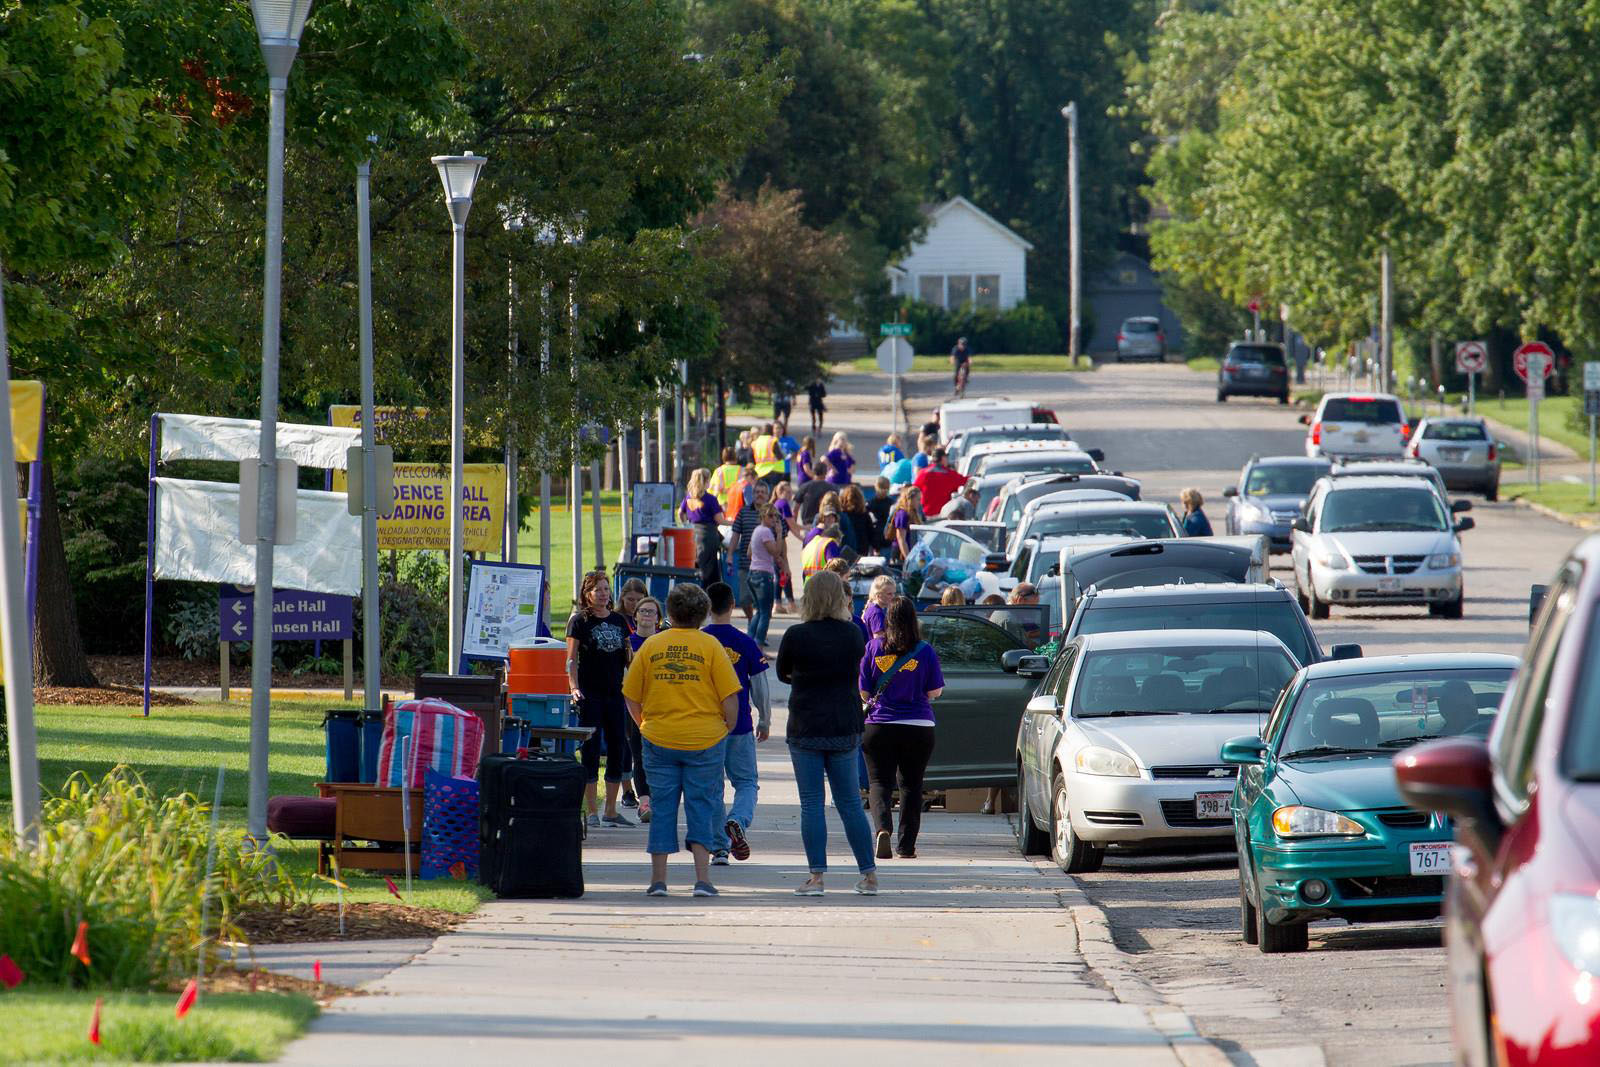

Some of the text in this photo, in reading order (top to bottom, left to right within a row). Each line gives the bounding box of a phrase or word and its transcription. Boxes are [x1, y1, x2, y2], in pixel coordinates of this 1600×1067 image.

[393, 485, 444, 500] DENCE
[463, 506, 490, 521] REA
[273, 600, 326, 613] ale Hall
[271, 620, 340, 633] nsen Hall
[1416, 851, 1450, 868] 767-
